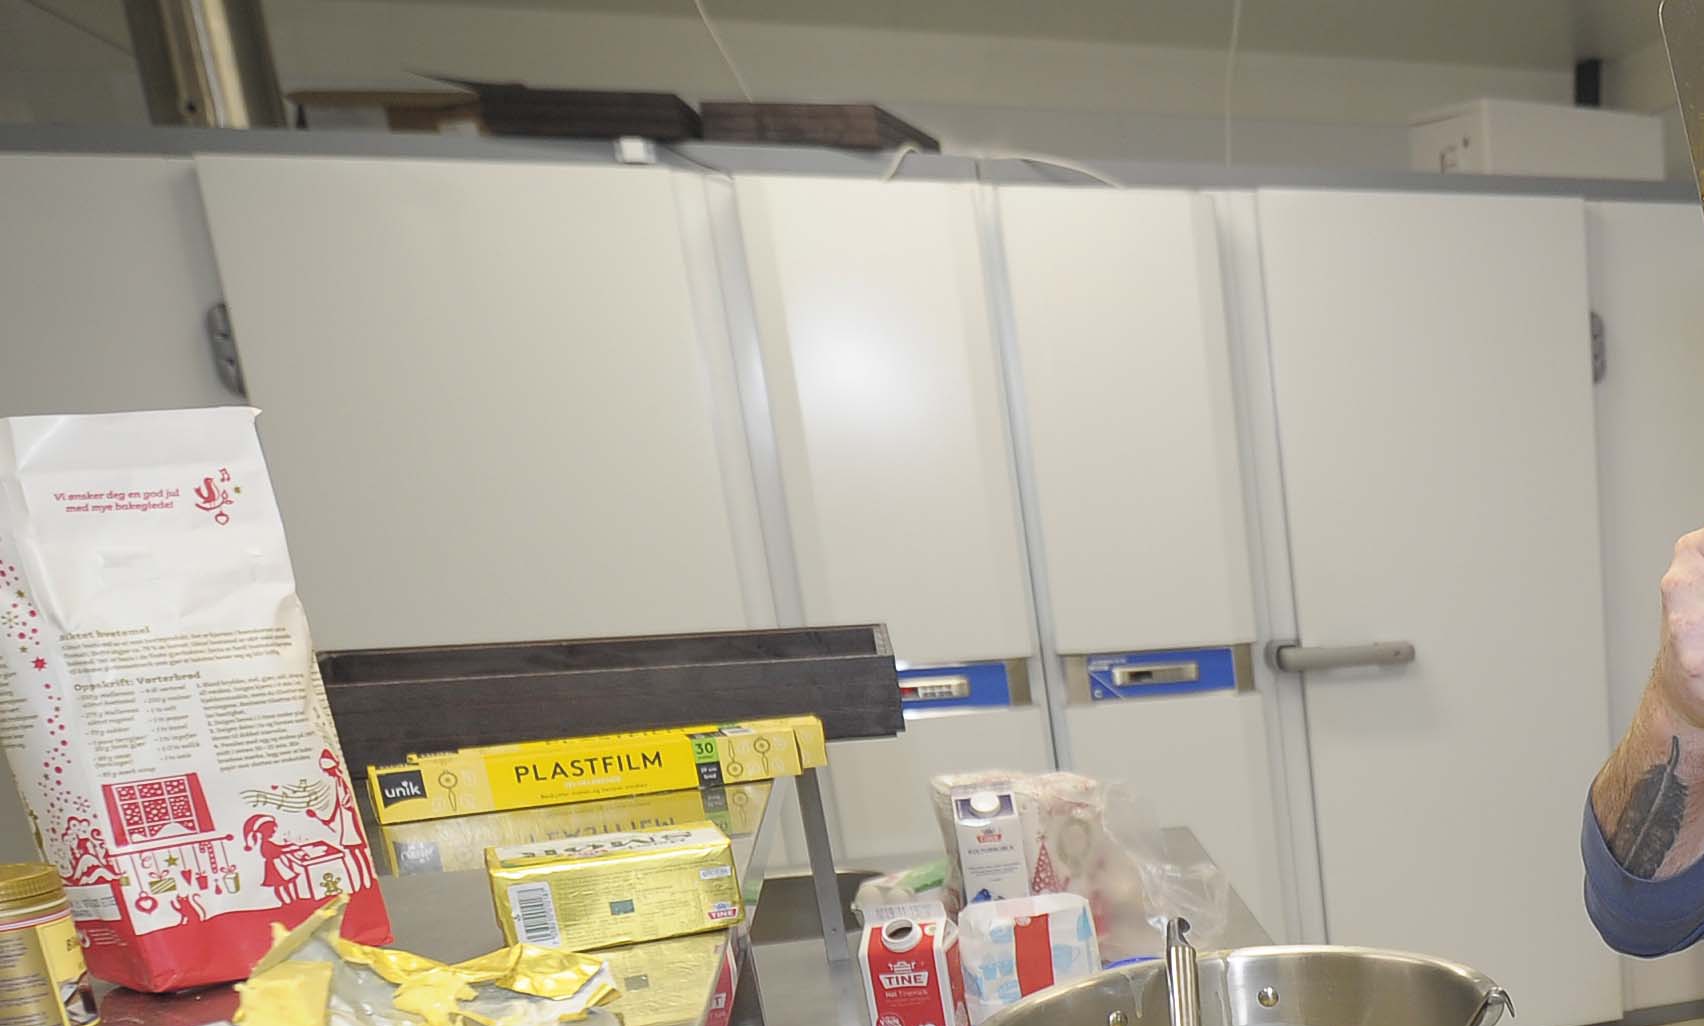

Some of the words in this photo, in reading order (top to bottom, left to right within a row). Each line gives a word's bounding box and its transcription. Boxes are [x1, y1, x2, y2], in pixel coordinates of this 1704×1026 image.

[54, 493, 66, 501] Vi
[106, 490, 125, 501] deg
[128, 491, 141, 499] en
[143, 489, 163, 500] god
[166, 488, 180, 499] jul
[66, 503, 89, 512] med
[91, 503, 113, 513] mye
[695, 742, 714, 755] 30
[515, 751, 663, 783] PLASTFILM
[385, 780, 422, 799] unik
[711, 909, 733, 919] TINE
[884, 974, 924, 986] TINE
